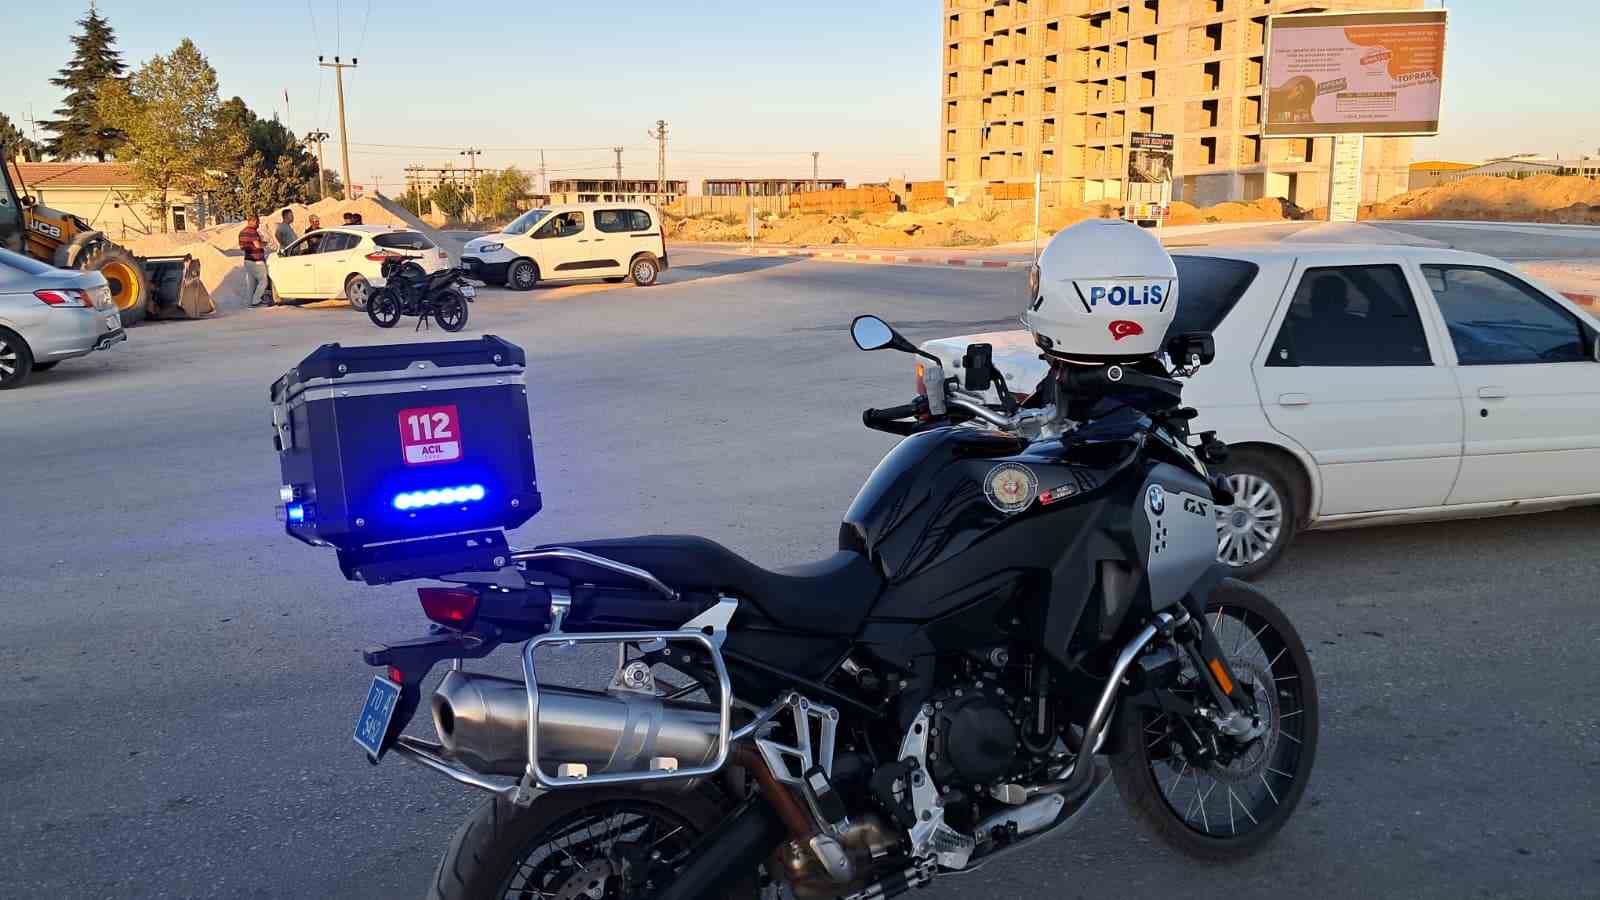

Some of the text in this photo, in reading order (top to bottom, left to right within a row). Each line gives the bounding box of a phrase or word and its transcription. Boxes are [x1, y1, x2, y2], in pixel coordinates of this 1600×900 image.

[33, 221, 61, 237] JCB
[408, 412, 452, 441] 112
[1184, 498, 1208, 517] GS
[370, 687, 384, 711] 70
